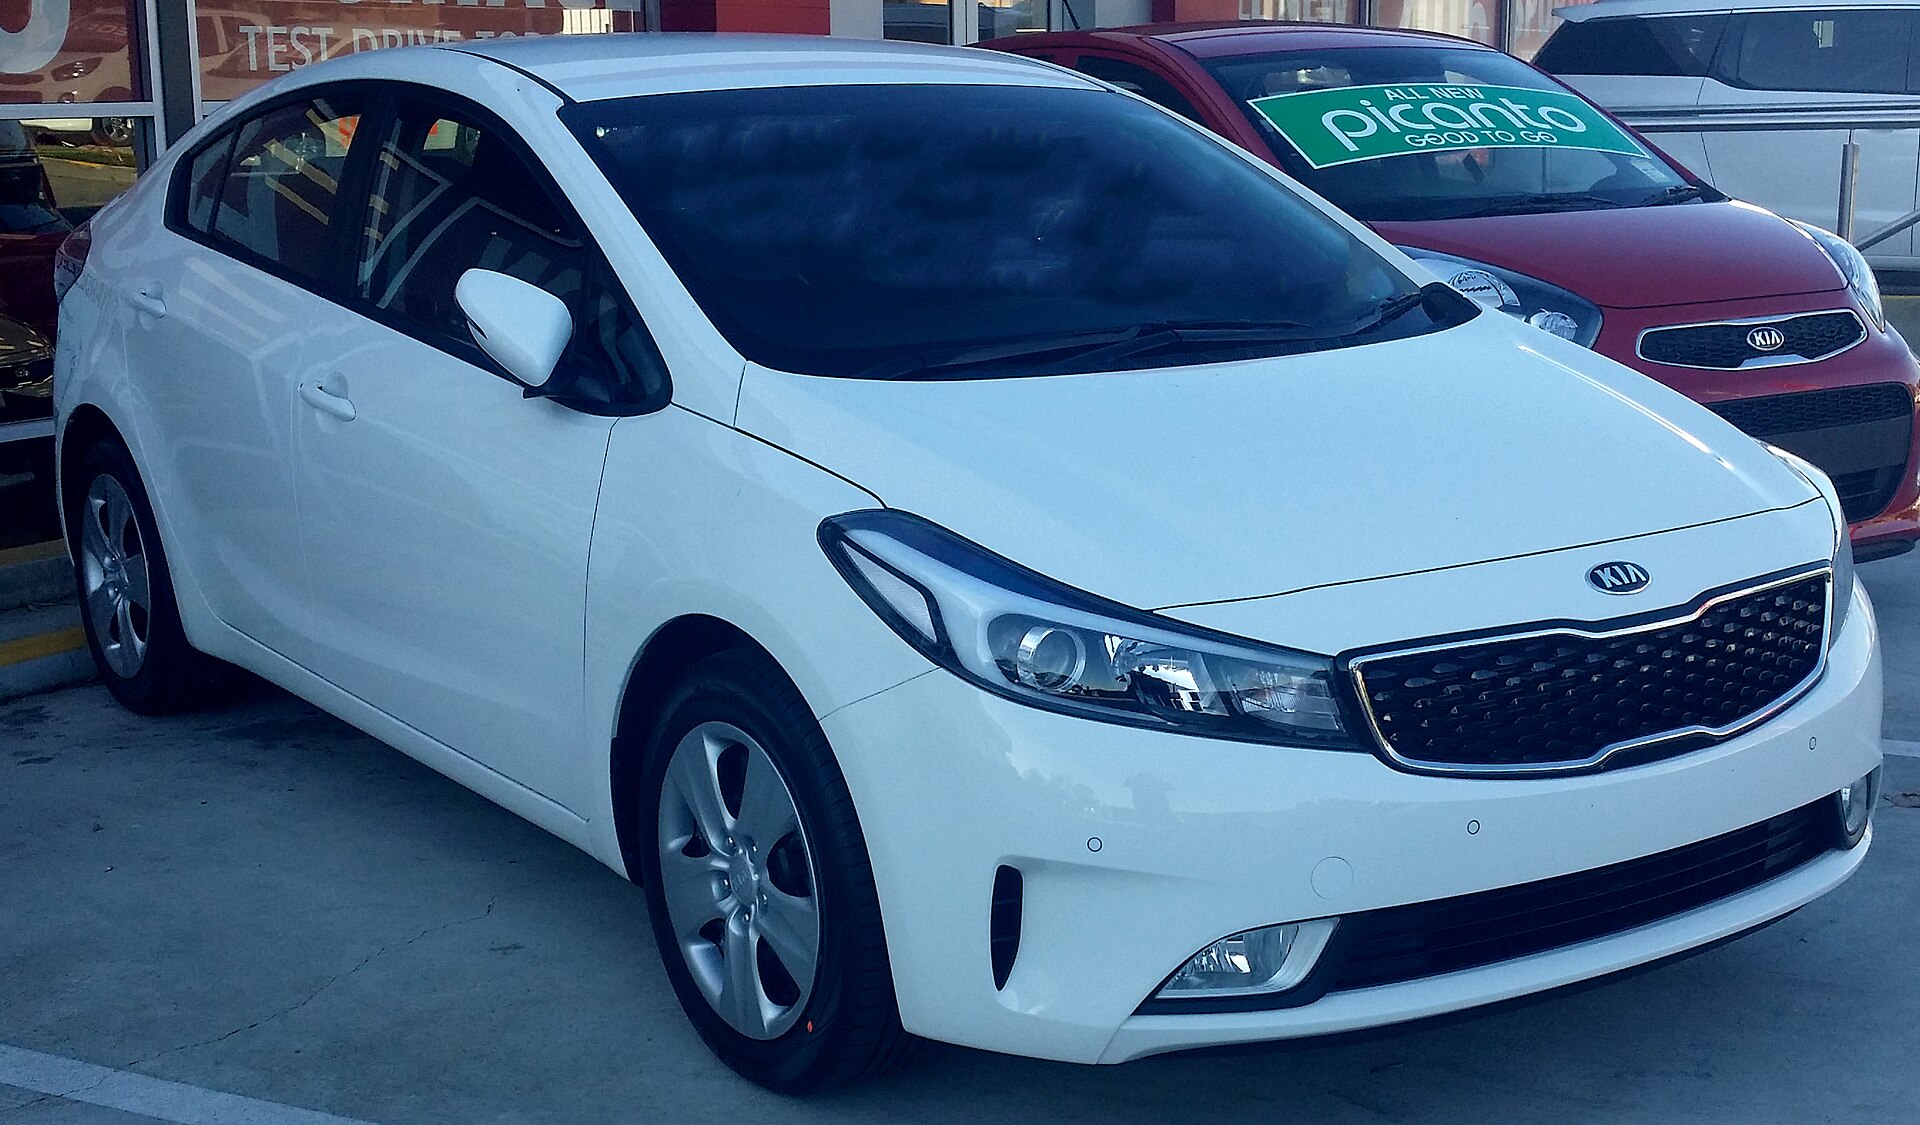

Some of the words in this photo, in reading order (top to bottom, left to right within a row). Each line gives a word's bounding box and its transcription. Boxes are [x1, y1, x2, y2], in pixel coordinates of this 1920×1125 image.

[239, 25, 334, 71] TEST
[1383, 87, 1429, 101] ALL
[1428, 87, 1486, 100] NEW
[1321, 97, 1587, 152] picanto
[1404, 131, 1480, 147] GOOD
[1480, 130, 1516, 143] TO
[1519, 130, 1559, 144] GO
[1752, 330, 1781, 346] KIA
[1593, 563, 1647, 589] KIA
